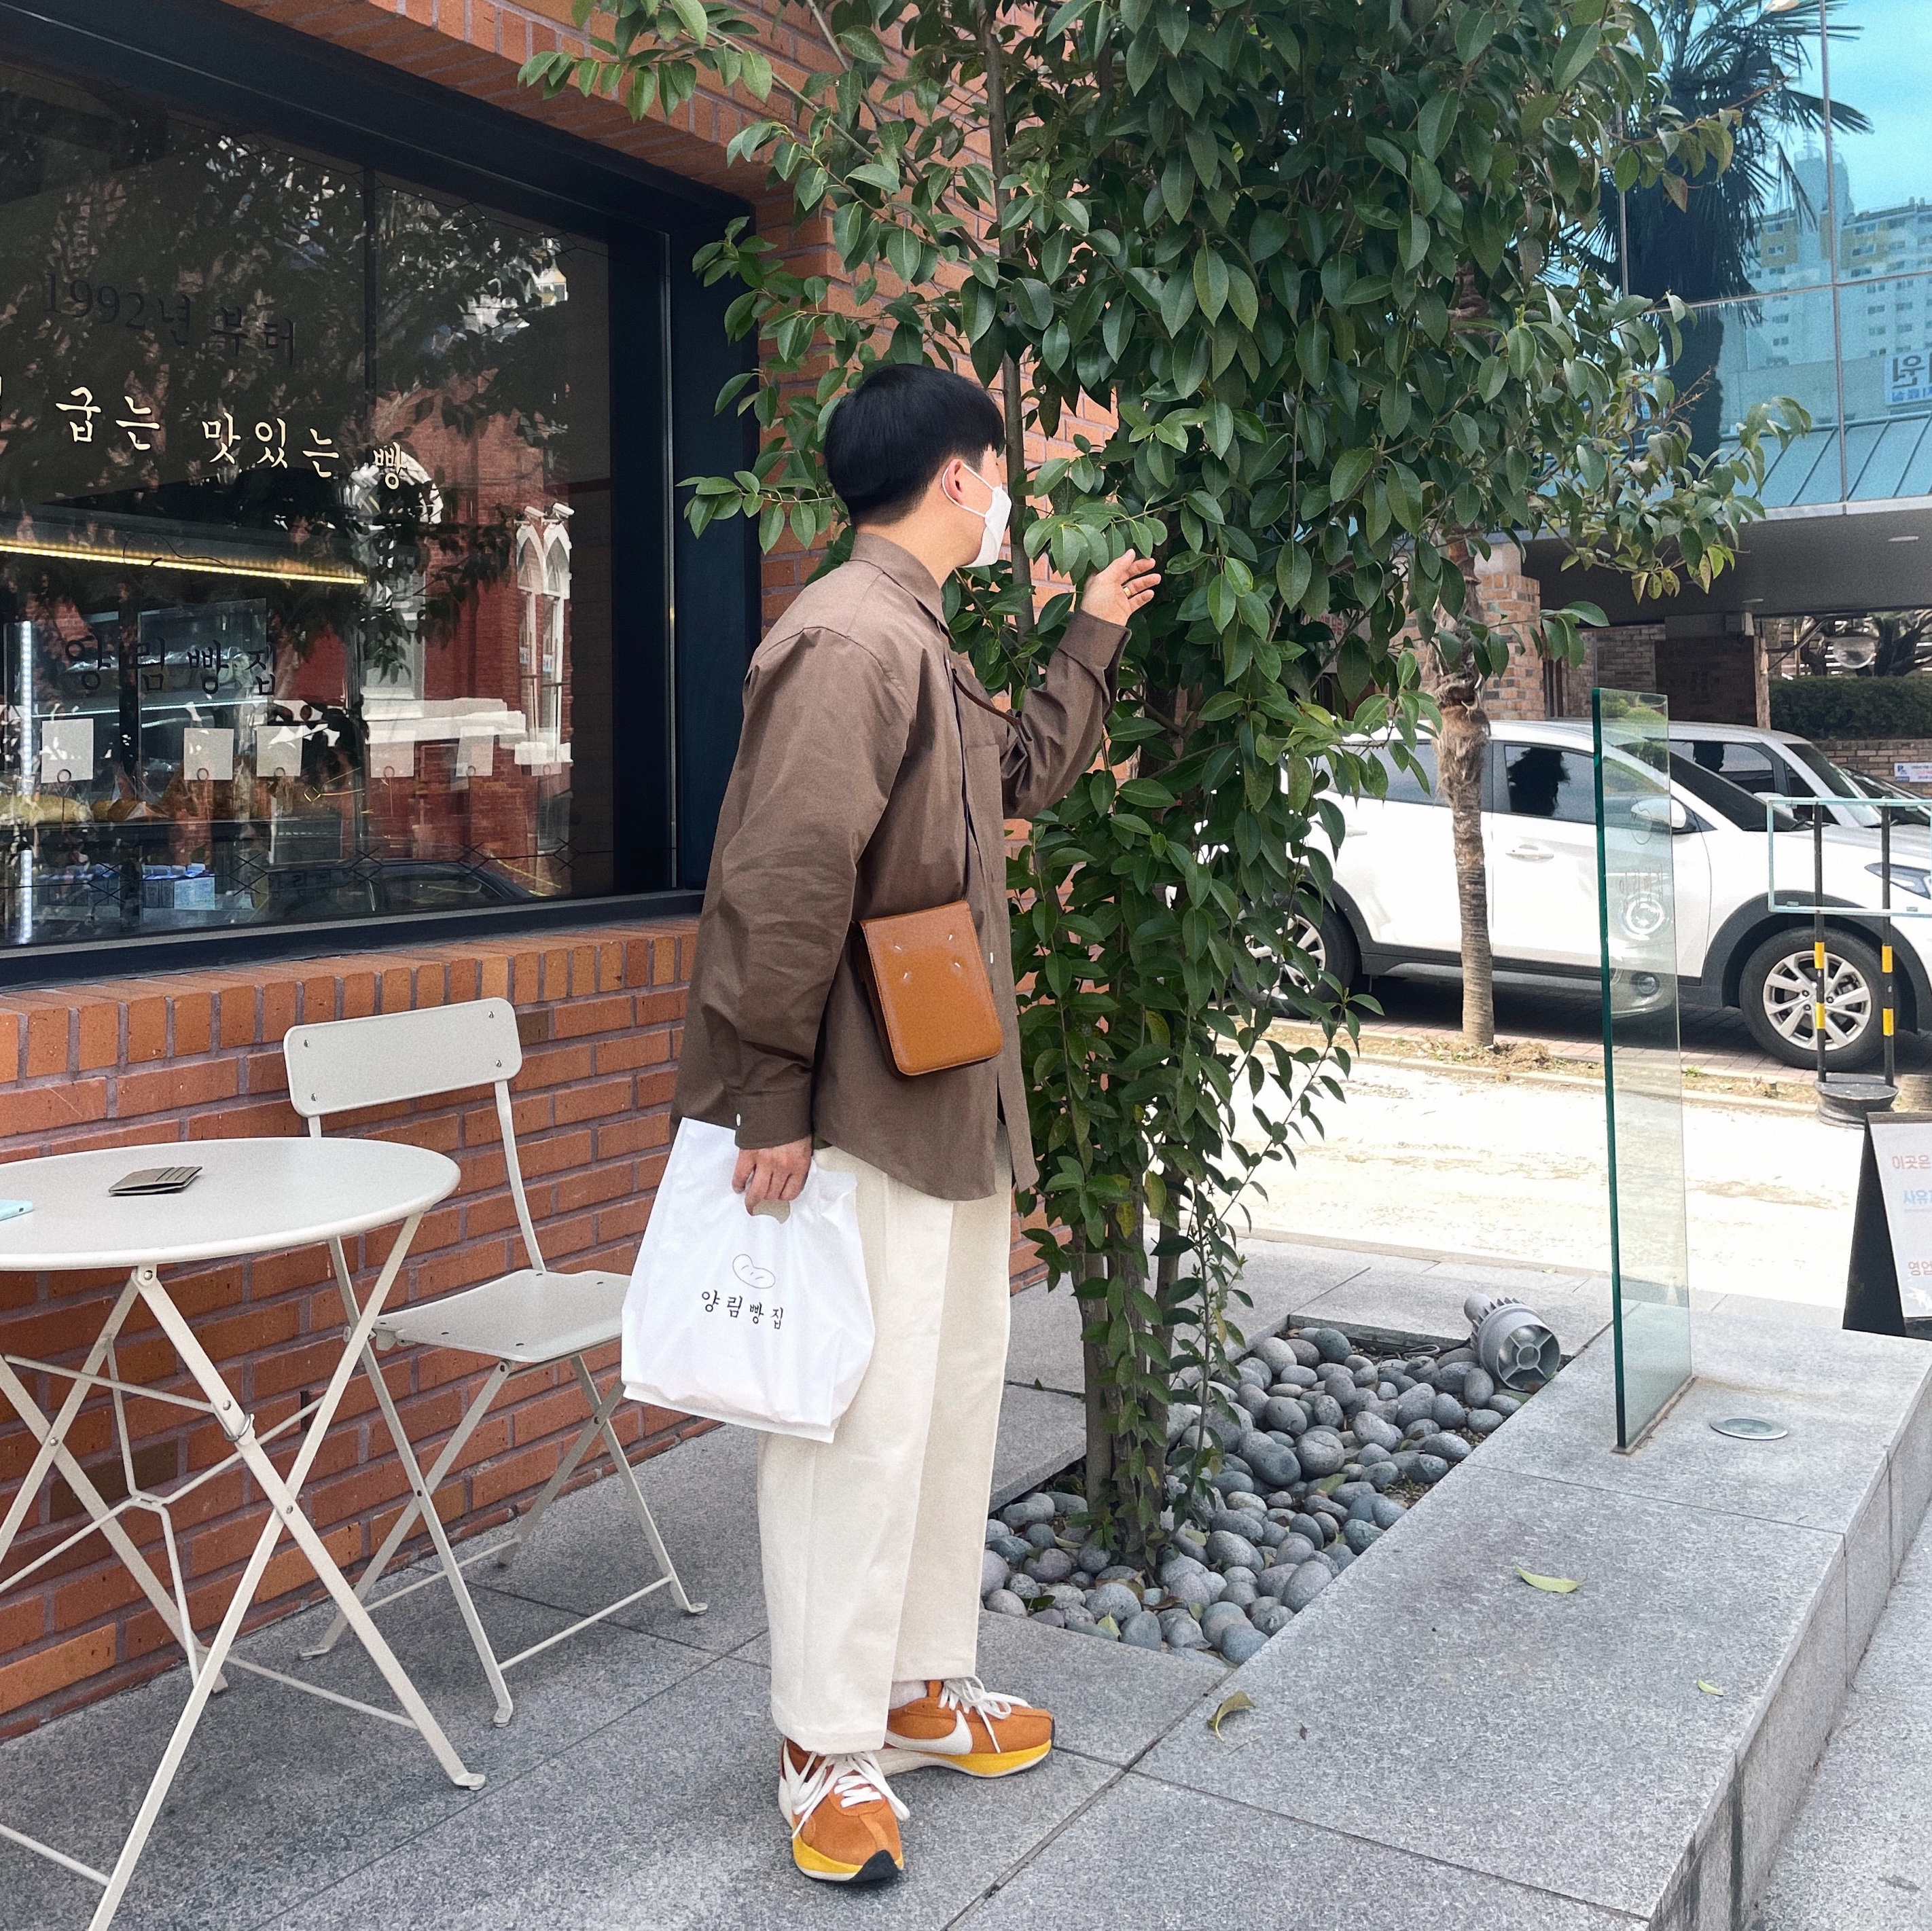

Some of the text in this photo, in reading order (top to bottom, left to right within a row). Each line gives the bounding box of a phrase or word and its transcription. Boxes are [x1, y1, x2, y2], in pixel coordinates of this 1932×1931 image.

[45, 272, 296, 365] 1992년 부터
[56, 386, 160, 450] 굽는
[202, 412, 339, 477] 맛있는
[372, 441, 407, 490] 빵
[1893, 1155, 1931, 1170] 이곳은
[701, 1289, 784, 1329] 양림빵집
